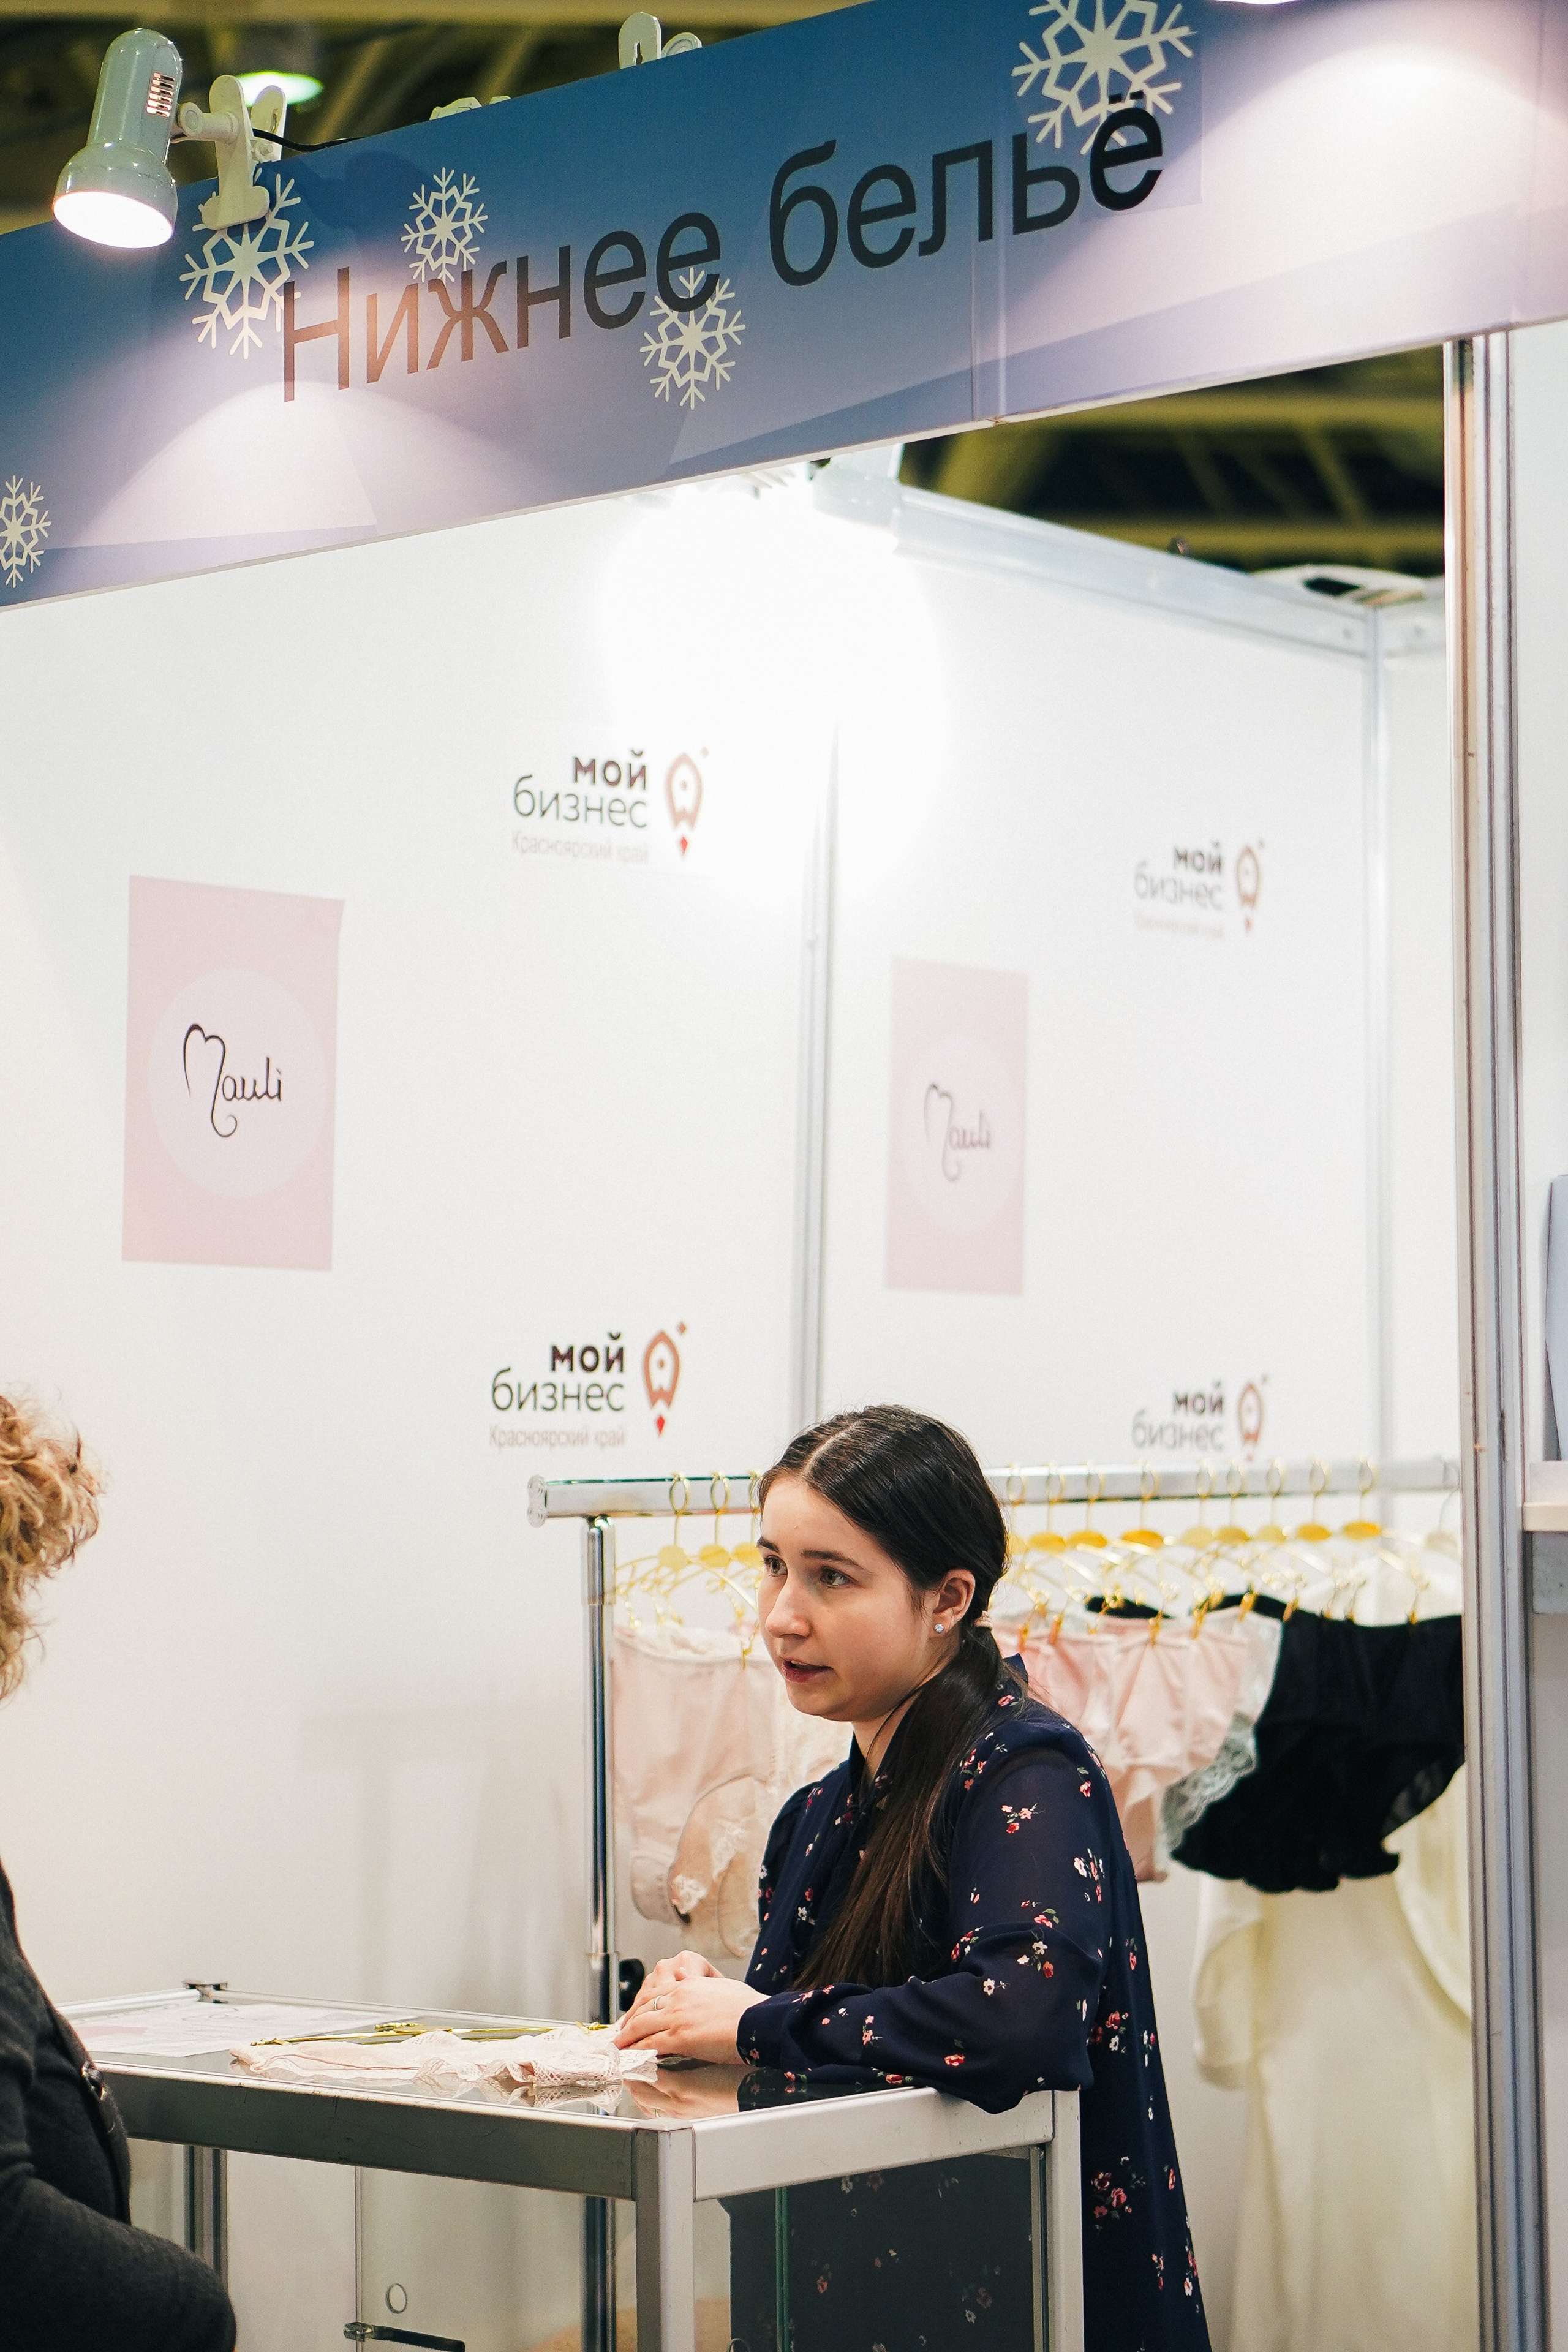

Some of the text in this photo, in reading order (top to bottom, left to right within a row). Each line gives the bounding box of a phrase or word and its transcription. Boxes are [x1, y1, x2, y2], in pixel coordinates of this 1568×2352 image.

[283, 89, 1163, 403] Нижнее бельё
[573, 747, 647, 791] мой
[513, 774, 647, 829] бизнес
[551, 1330, 624, 1373] мой
[491, 1366, 625, 1411] бизнес
